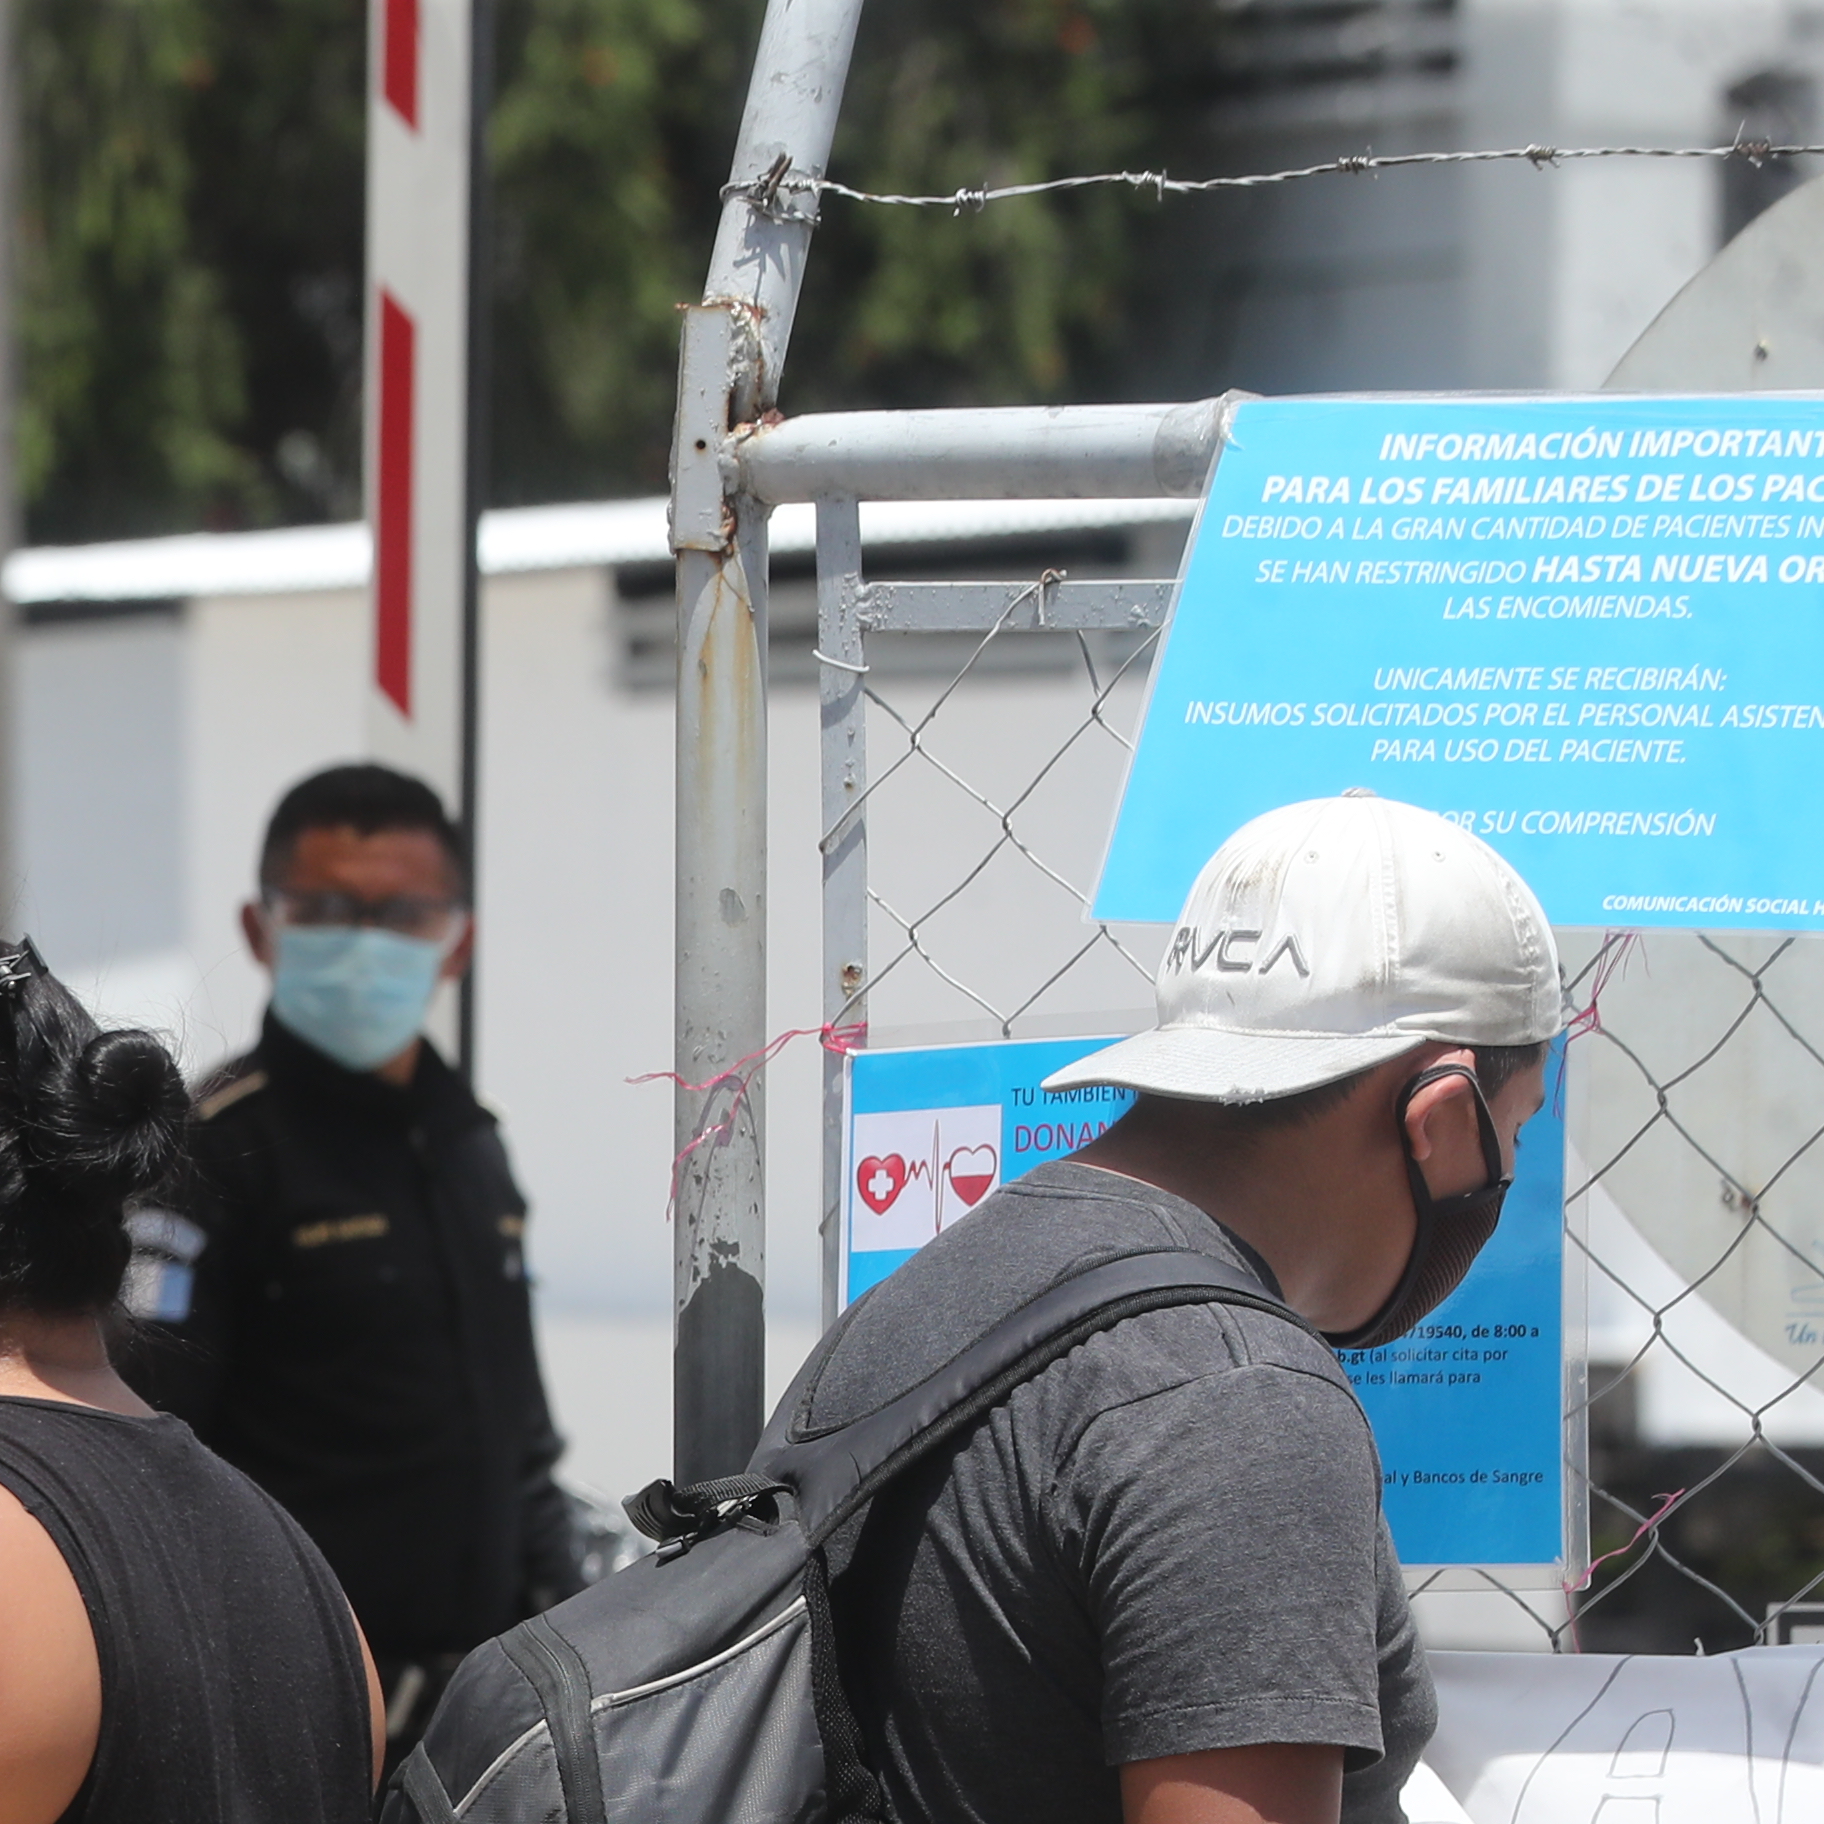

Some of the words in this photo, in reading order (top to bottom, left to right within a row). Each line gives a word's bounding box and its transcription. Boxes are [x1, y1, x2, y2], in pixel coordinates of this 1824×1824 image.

[1379, 426, 1624, 461] INFORMACIÓN
[1261, 476, 1350, 503] PARA
[1359, 476, 1426, 505] LOS
[1431, 475, 1630, 504] FAMILIARES
[1635, 474, 1684, 502] DE
[1688, 474, 1756, 502] LOS
[1761, 474, 1824, 502] PAC
[1221, 515, 1322, 539] DEBIDO
[1326, 517, 1344, 540] A
[1352, 517, 1383, 540] LA
[1391, 516, 1466, 540] GRAN
[1470, 515, 1606, 540] CANTIDAD
[1611, 515, 1648, 538] DE
[1652, 514, 1791, 539] PACIENTES
[1255, 560, 1288, 583] SE
[1291, 561, 1351, 584] HAN
[1355, 560, 1527, 584] RESTRINGIDO
[1531, 555, 1640, 583] HASTA
[1650, 554, 1768, 583] NUEVA
[1778, 555, 1824, 584] OR
[1443, 596, 1492, 619] LAS
[1496, 595, 1693, 619] ENCOMIENDAS.
[1373, 667, 1544, 691] UNICAMENTE
[1547, 667, 1580, 691] SE
[1584, 663, 1728, 692] RECIBIRÁN:
[1184, 701, 1306, 726] INSUMOS
[1310, 703, 1479, 726] SOLICITADOS
[1482, 702, 1537, 727] POR
[1542, 703, 1571, 727] EL
[1577, 703, 1714, 728] PERSONAL
[1720, 704, 1824, 729] ASISTEN
[1370, 739, 1435, 762] PARA
[1444, 738, 1499, 762] USO
[1503, 739, 1552, 762] DEL
[1558, 739, 1686, 764] PACIENTE.
[1479, 811, 1517, 835] SU
[1520, 809, 1717, 837] COMPRENSIÓN
[1602, 894, 1743, 913] COMUNICACIÓN
[1745, 899, 1809, 915] SOCIAL
[1011, 1088, 1035, 1106] TU
[1471, 1324, 1489, 1337] de
[1494, 1324, 1526, 1337] 8:00
[1532, 1327, 1539, 1337] a
[1370, 1348, 1387, 1362] (al
[1390, 1347, 1448, 1361] solicitar
[1452, 1347, 1478, 1360] cita
[1483, 1349, 1508, 1363] por
[1366, 1370, 1385, 1383] les
[1390, 1369, 1443, 1383] llamará
[1448, 1373, 1481, 1385] para
[1402, 1472, 1408, 1485] y
[1414, 1469, 1465, 1483] Bancos
[1470, 1469, 1488, 1482] de
[1492, 1469, 1544, 1485] Sangre
